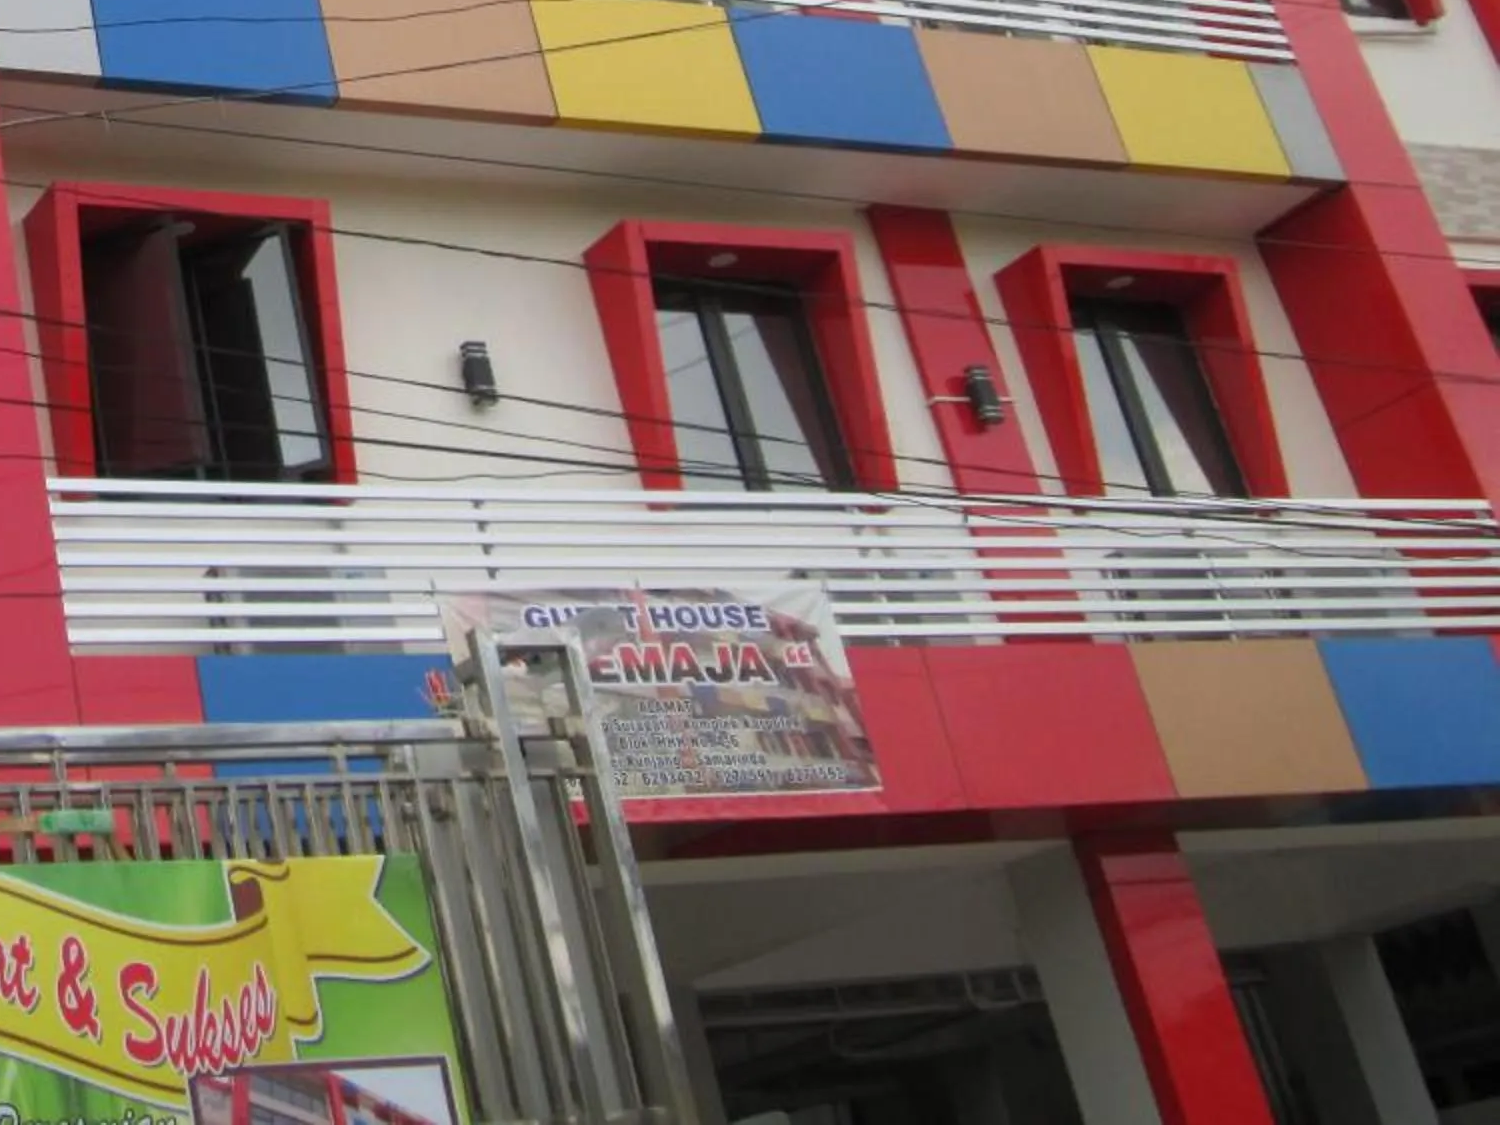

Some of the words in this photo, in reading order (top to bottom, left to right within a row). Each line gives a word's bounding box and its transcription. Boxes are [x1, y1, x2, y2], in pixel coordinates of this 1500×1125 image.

[524, 605, 640, 629] GUT
[651, 605, 768, 630] HOUSE
[588, 644, 775, 685] EMAJA
[638, 699, 692, 714] ALAMAT
[56, 935, 100, 1043] &
[119, 961, 277, 1073] Sukses
